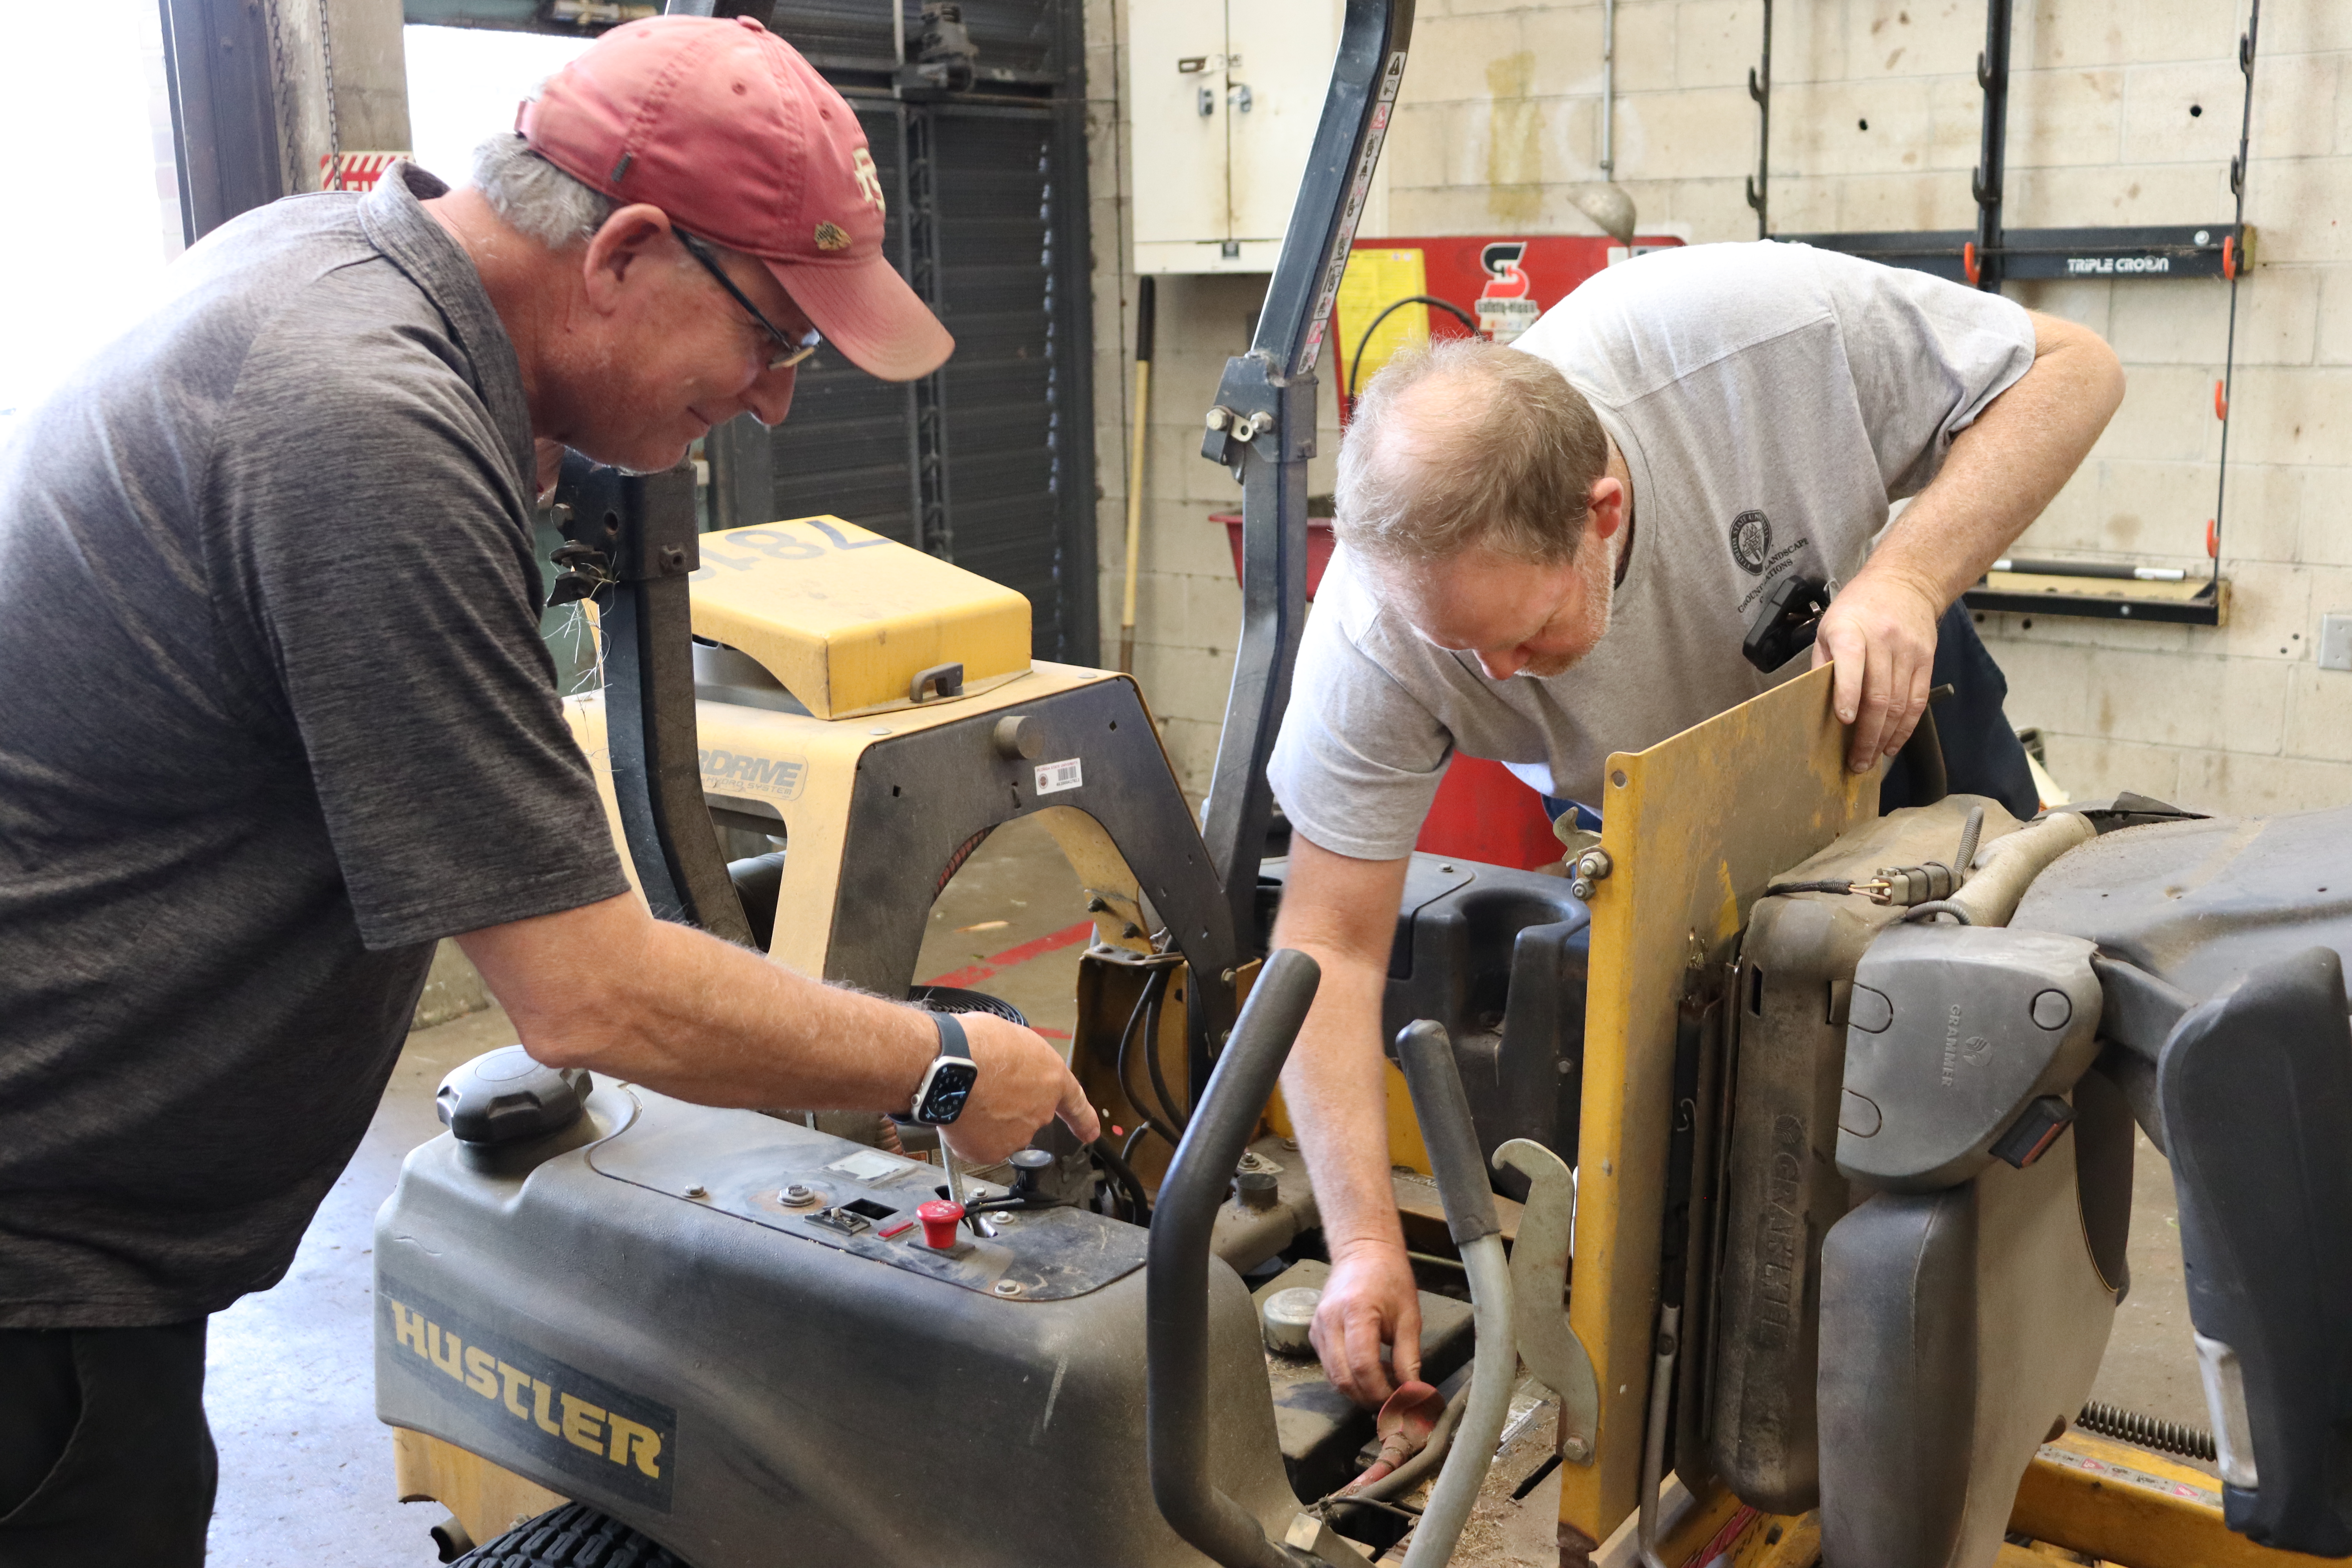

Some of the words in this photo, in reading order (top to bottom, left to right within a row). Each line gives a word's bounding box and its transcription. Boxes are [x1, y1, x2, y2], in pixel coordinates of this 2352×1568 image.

[2067, 258, 2113, 272] TRIPLE
[698, 749, 803, 788] RDRIVE
[706, 775, 744, 788] HYDRO
[747, 782, 792, 795] SYSTEM
[1941, 1004, 1960, 1087] GRAMMER
[390, 1298, 661, 1479] HUSTLER
